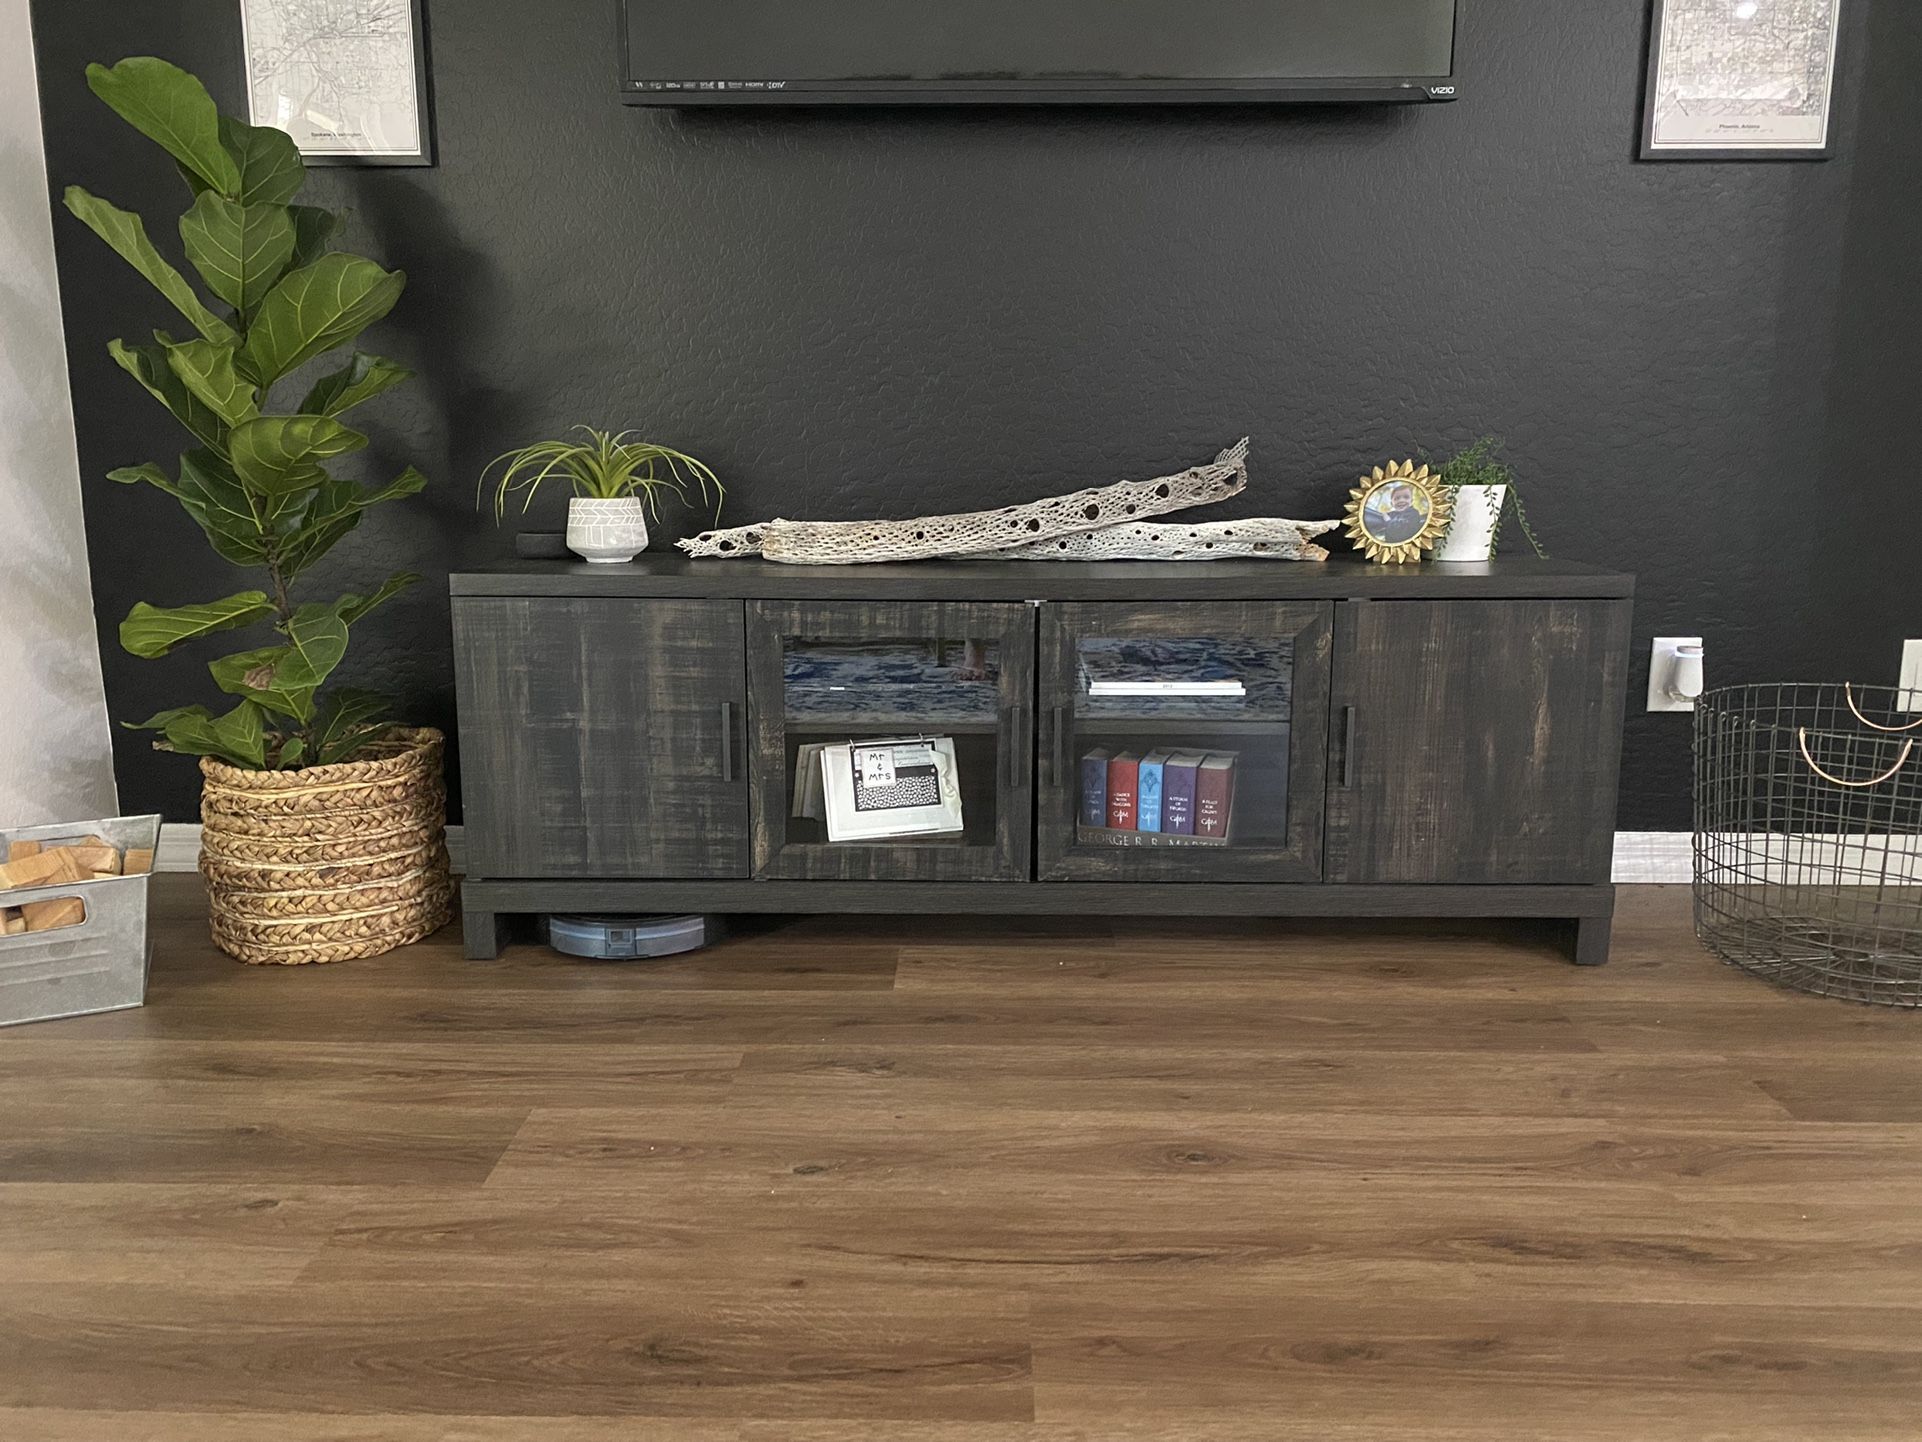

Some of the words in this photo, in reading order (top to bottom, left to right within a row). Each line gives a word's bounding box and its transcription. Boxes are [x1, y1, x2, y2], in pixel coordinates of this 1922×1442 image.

[1431, 86, 1455, 94] VIZIO
[869, 753, 885, 761] Mr
[1078, 831, 1129, 846] GEORGE
[1134, 836, 1142, 846] R
